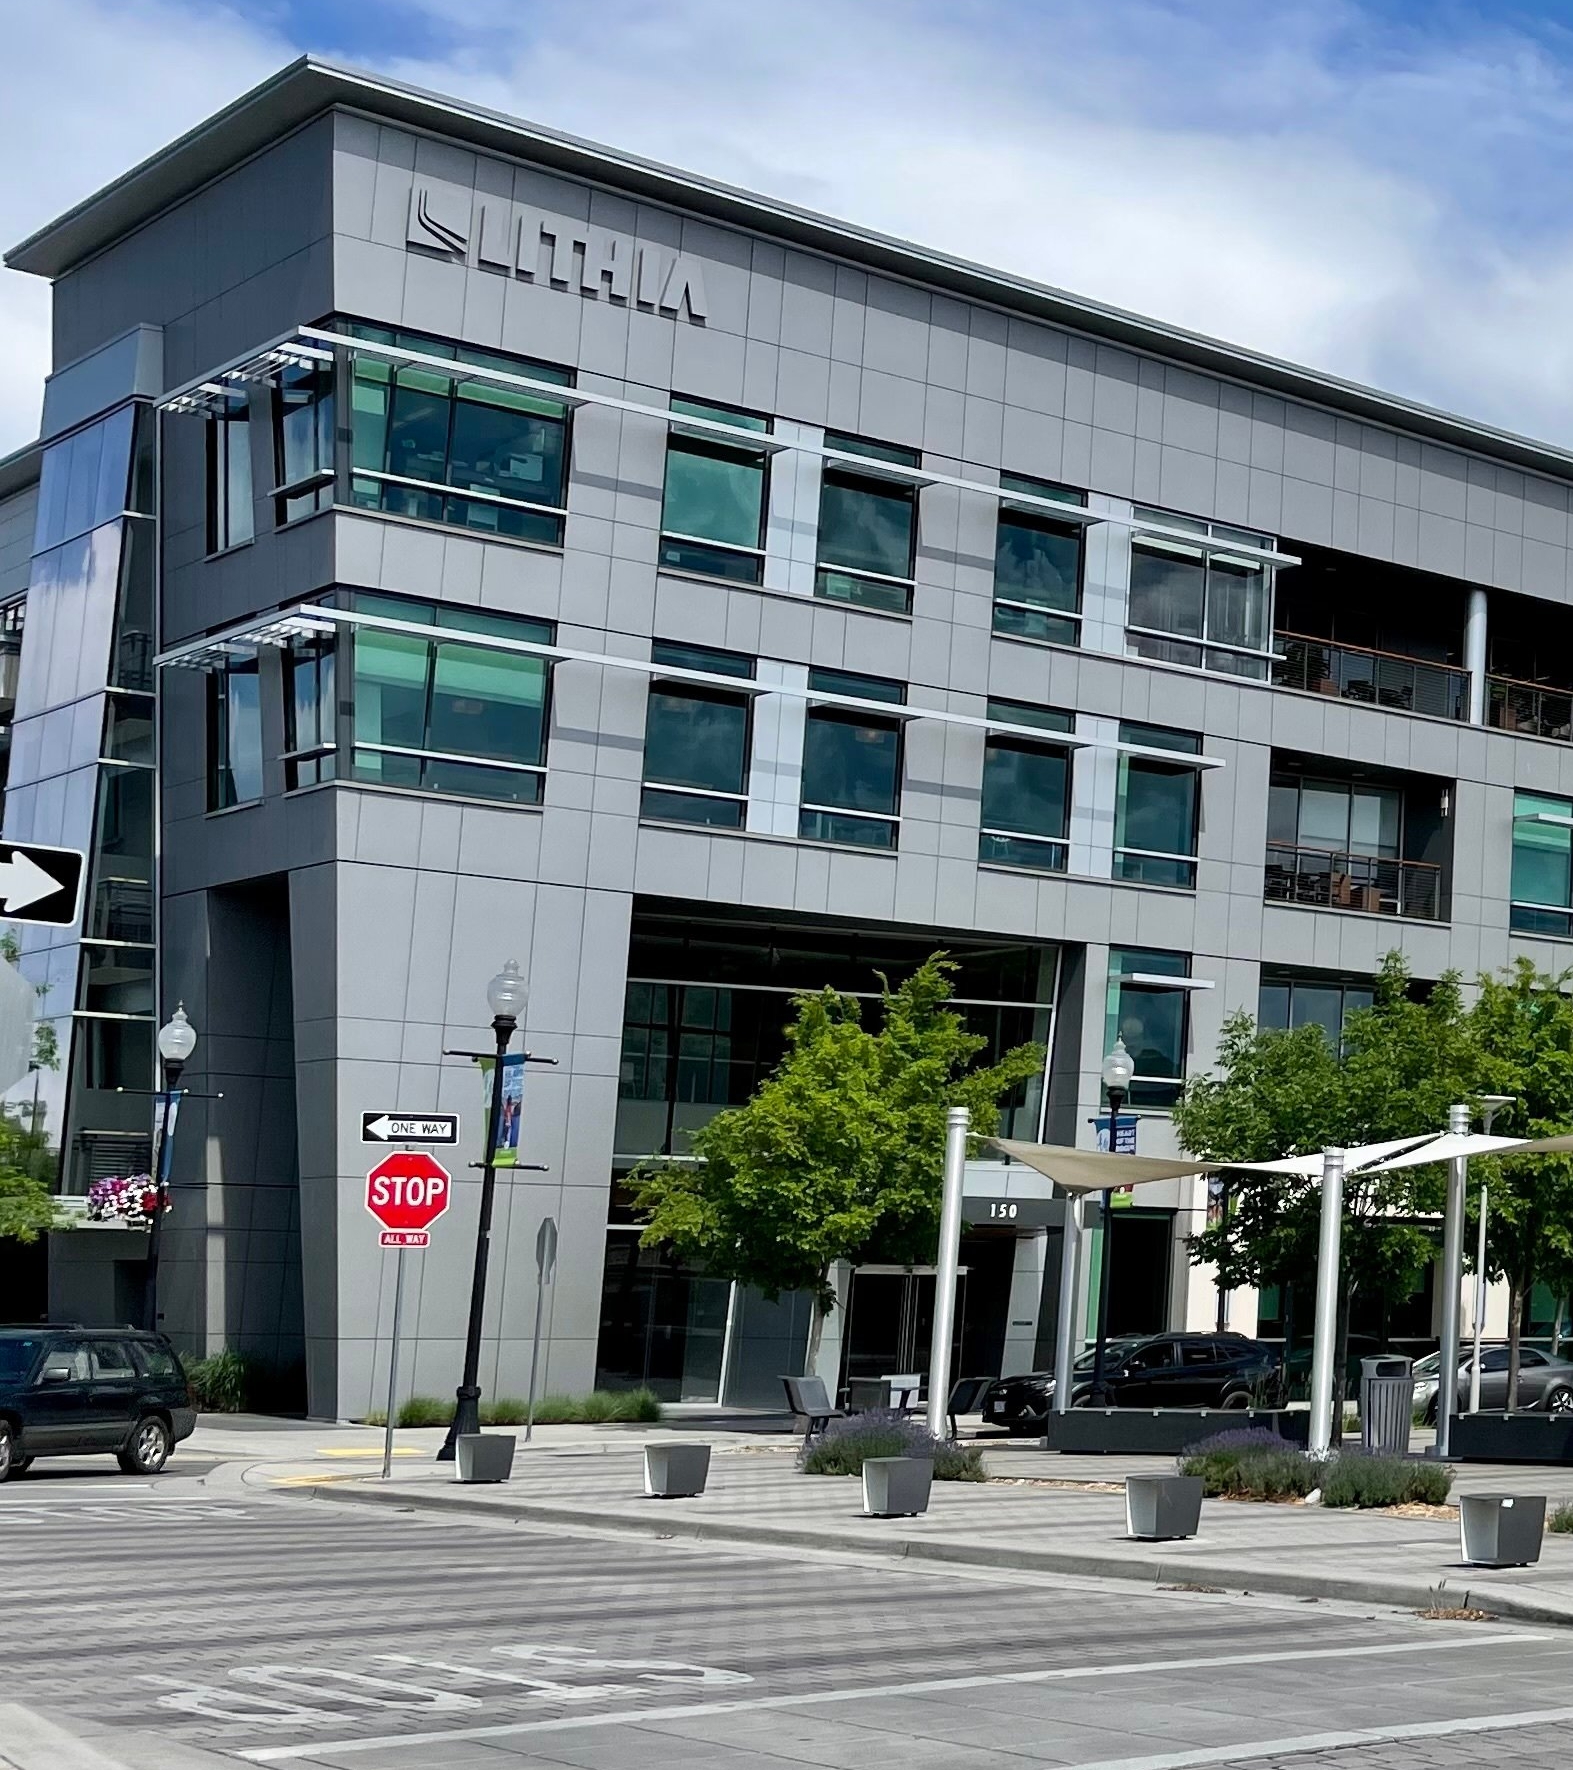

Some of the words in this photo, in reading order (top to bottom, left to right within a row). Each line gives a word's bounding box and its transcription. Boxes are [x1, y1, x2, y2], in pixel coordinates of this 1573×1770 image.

[478, 204, 708, 325] LITHIA
[391, 1122, 417, 1134] ONE
[422, 1123, 448, 1135] WAY
[372, 1175, 445, 1206] STOP
[990, 1203, 1018, 1218] 150
[384, 1234, 402, 1244] ALL
[405, 1234, 425, 1244] WAY
[130, 1645, 754, 1724] STOP
